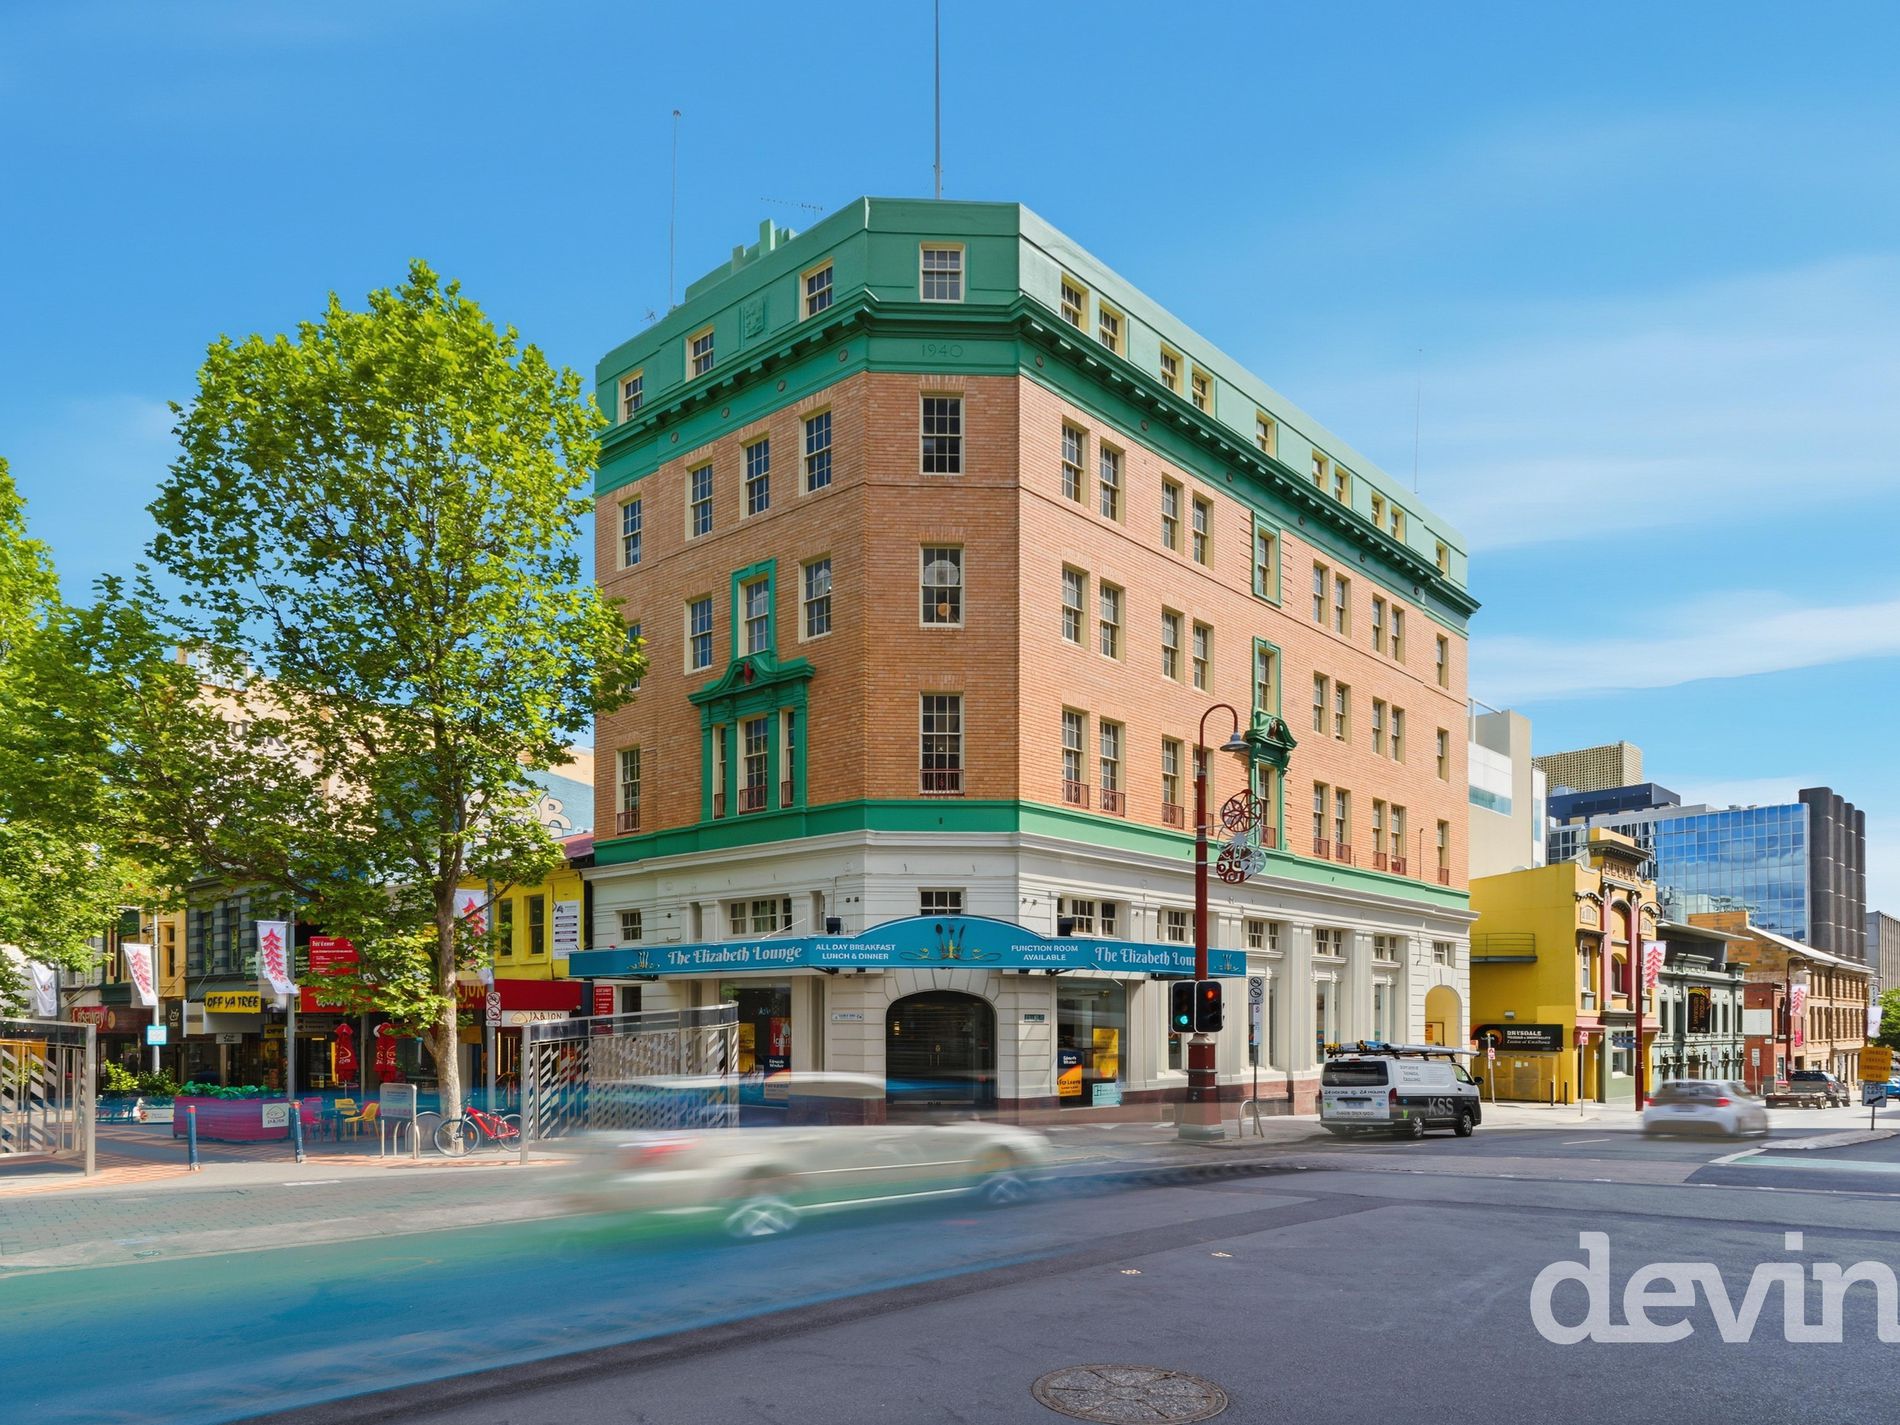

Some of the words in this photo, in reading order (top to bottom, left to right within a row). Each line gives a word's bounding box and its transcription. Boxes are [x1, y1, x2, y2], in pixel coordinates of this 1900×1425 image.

[921, 344, 964, 357] 1940
[815, 943, 831, 951] ALL
[832, 943, 848, 951] DAY
[1011, 944, 1052, 952] FUNCTION
[667, 950, 691, 965] The
[693, 947, 750, 964] Elizabeth
[752, 946, 802, 963] Lounge
[1095, 946, 1118, 963] The
[1120, 948, 1170, 966] Elizabeth
[1172, 951, 1196, 967] Lou
[207, 996, 223, 1008] OFF
[225, 995, 236, 1009] YA
[237, 996, 258, 1008] TREE
[1428, 1097, 1454, 1116] KSS
